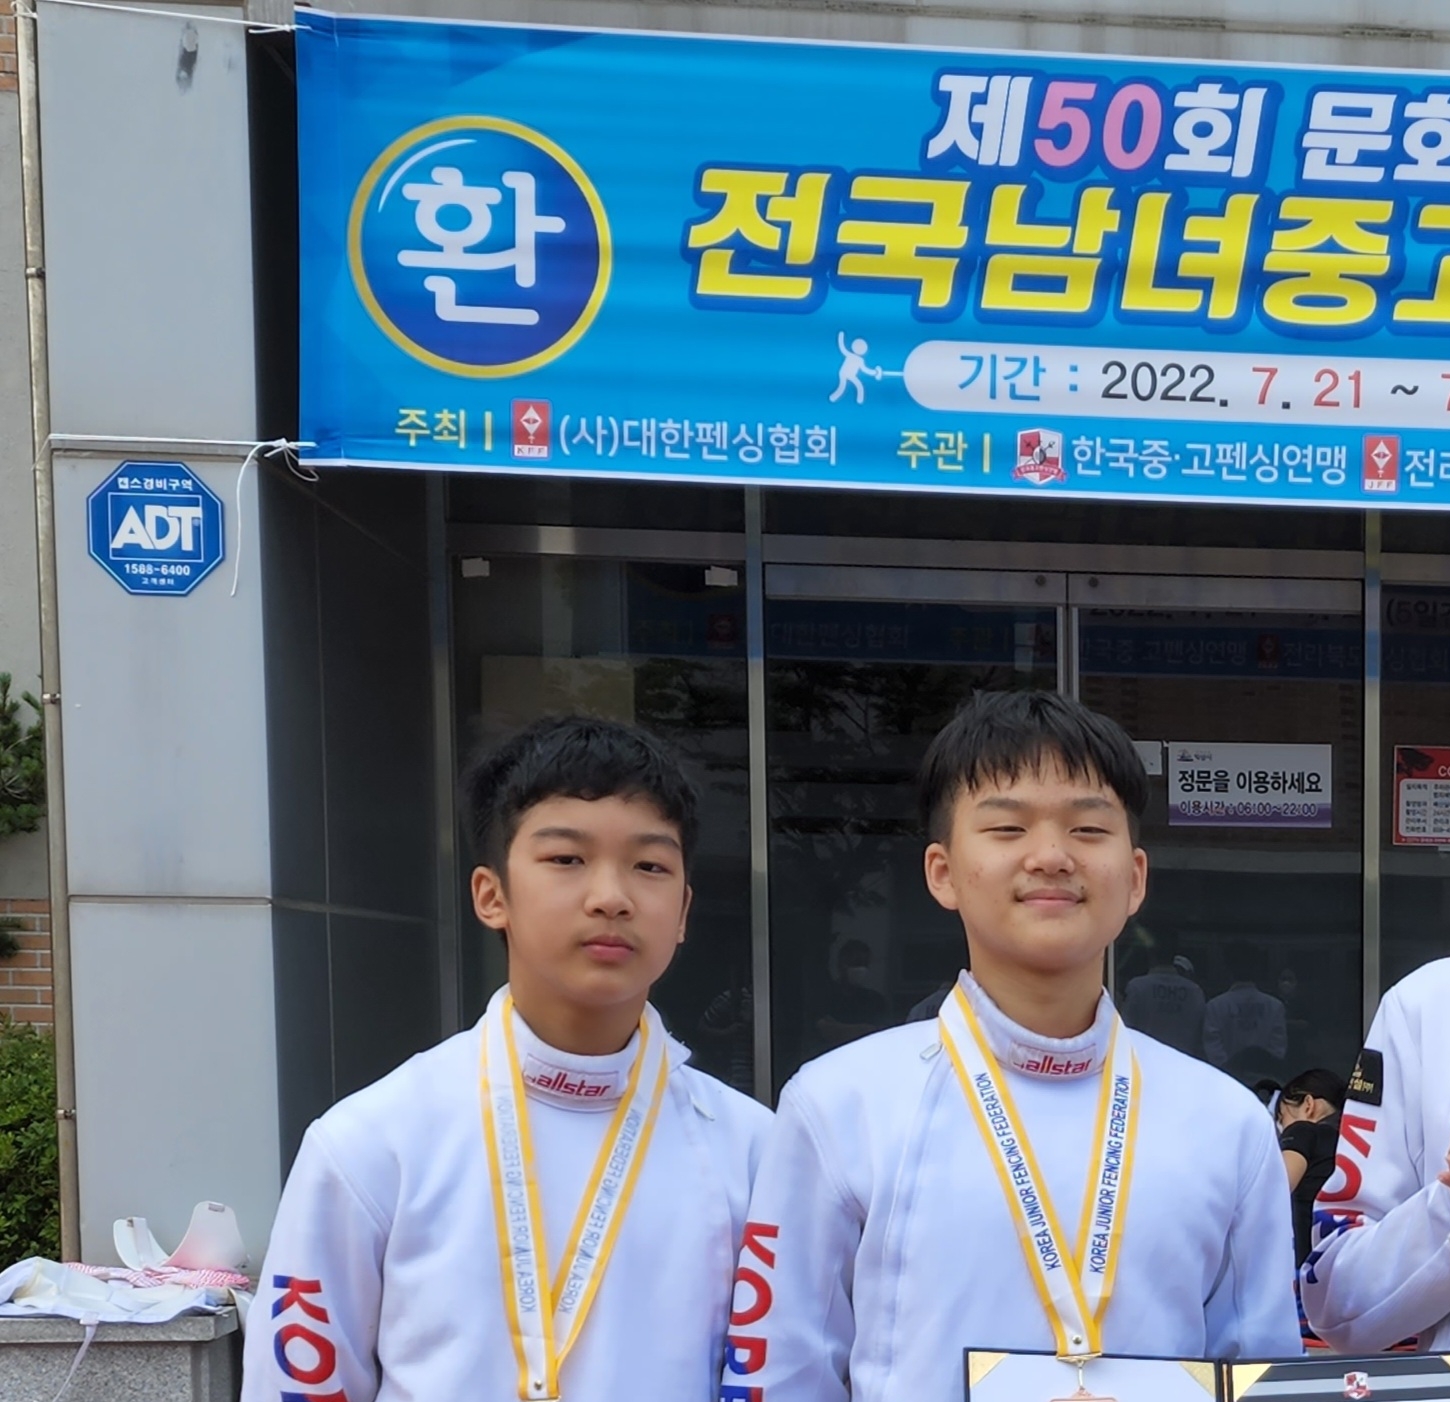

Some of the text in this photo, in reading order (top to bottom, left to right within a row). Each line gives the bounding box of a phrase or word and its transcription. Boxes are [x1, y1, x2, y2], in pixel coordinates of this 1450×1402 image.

[927, 73, 1269, 178] 제50회
[398, 165, 567, 326] 환
[958, 353, 1046, 402] 기간
[1101, 360, 1229, 408] 2022.
[1313, 369, 1363, 408] 21
[395, 408, 466, 449] 주최
[559, 413, 837, 466] (사)대한펜싱협회
[897, 431, 968, 472] 주관
[1072, 435, 1348, 485] 한국중·고펜싱연맹
[110, 504, 203, 551] ADT
[124, 563, 191, 577] 1588-6400
[1178, 769, 1322, 794] 정문을 이용하세요
[1179, 800, 1226, 816] 이용시간
[1236, 801, 1318, 818] 06:00~22:00
[535, 1070, 611, 1098] allstar
[1023, 1055, 1093, 1076] allstar
[975, 1073, 1061, 1271] KOREA JUNIOR FENCING FEDERATION
[1090, 1075, 1130, 1273] KOREA JUNIOR FENCING FEDERATION
